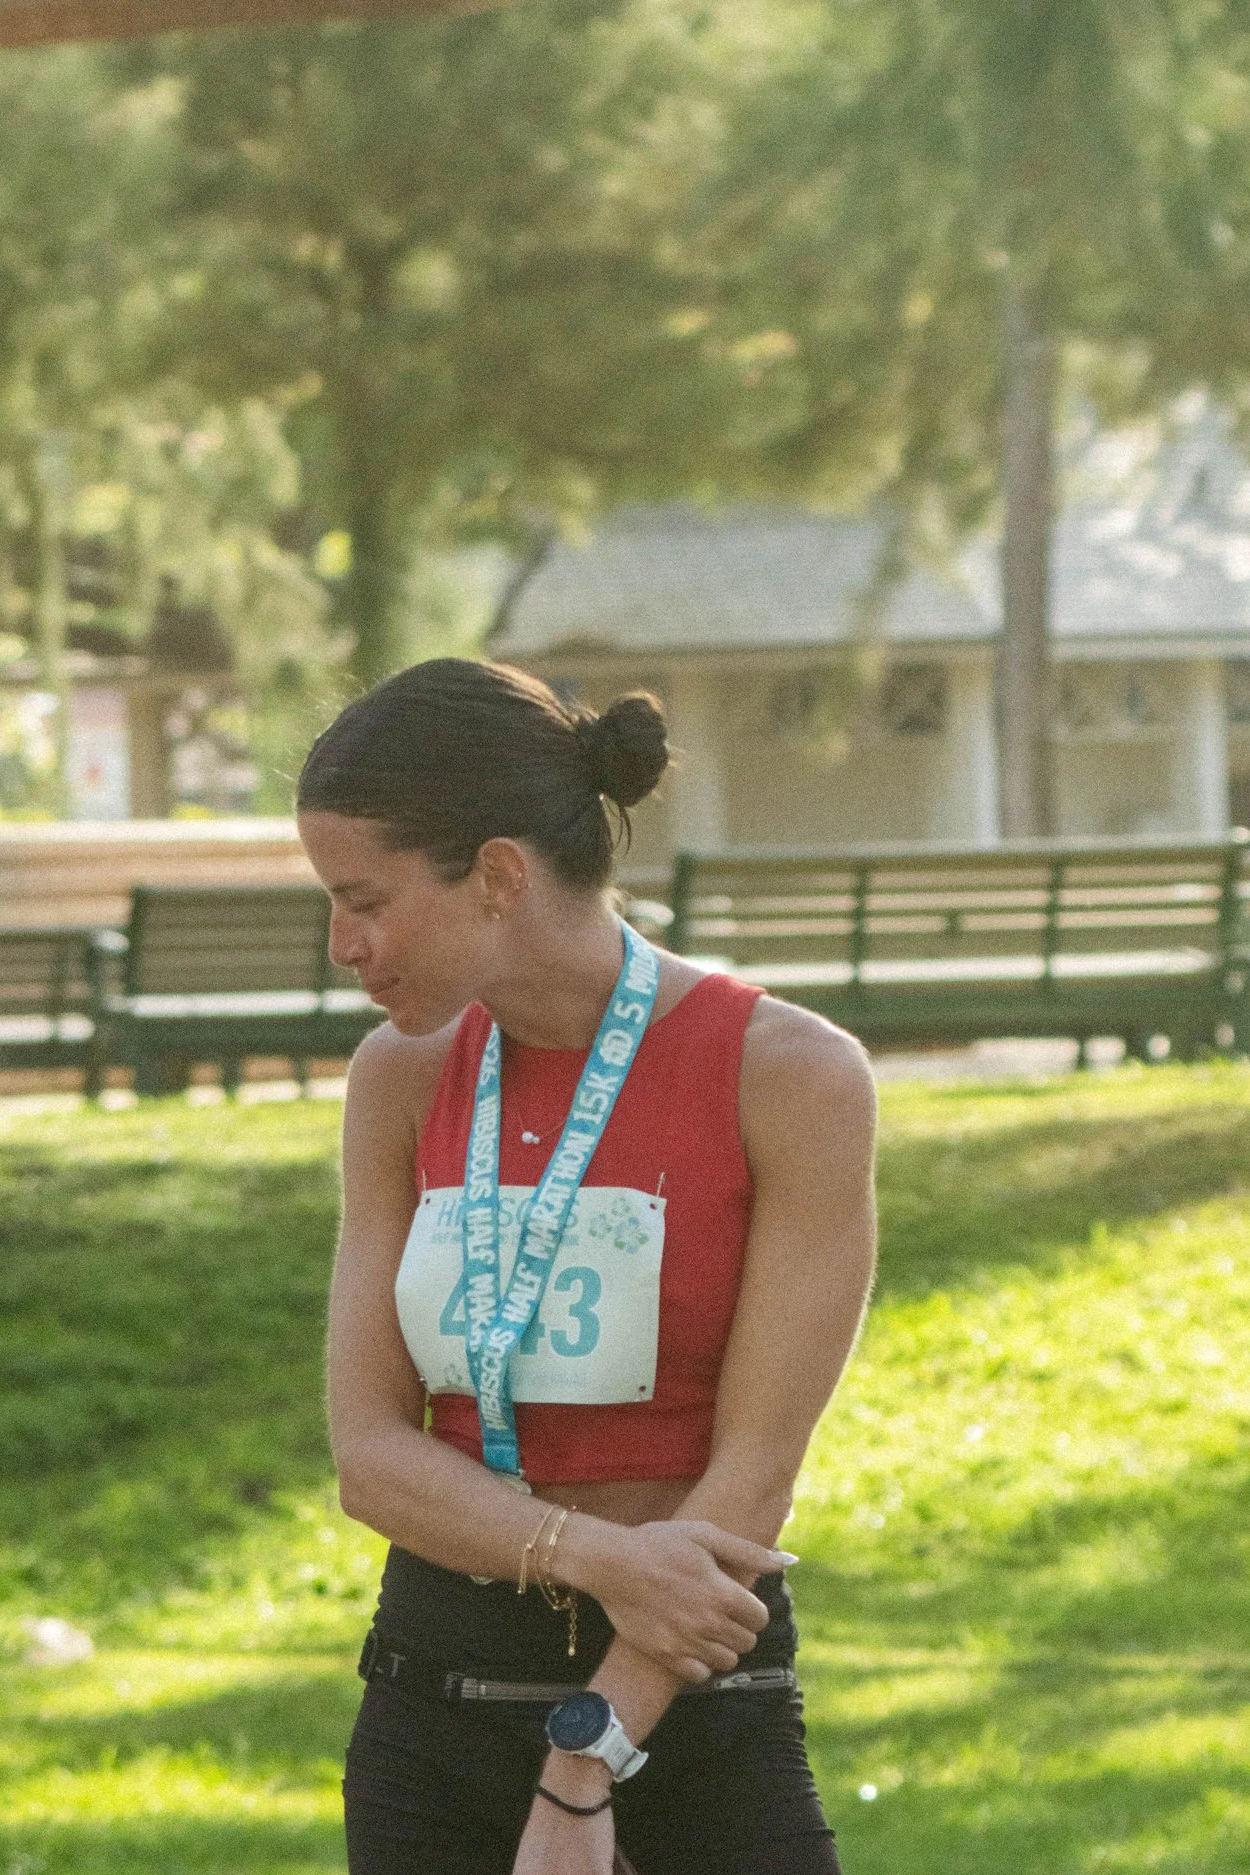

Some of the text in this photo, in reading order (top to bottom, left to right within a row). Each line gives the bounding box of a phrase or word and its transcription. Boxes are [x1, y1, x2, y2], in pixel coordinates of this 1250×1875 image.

[468, 1094, 498, 1201] HIBISCUS
[465, 1207, 496, 1266] HALF
[479, 1327, 517, 1431] HIBISCUS
[501, 1262, 542, 1324] HALF
[523, 1130, 596, 1260] MARATHON
[573, 1070, 619, 1126] 15K
[613, 999, 646, 1025] 5
